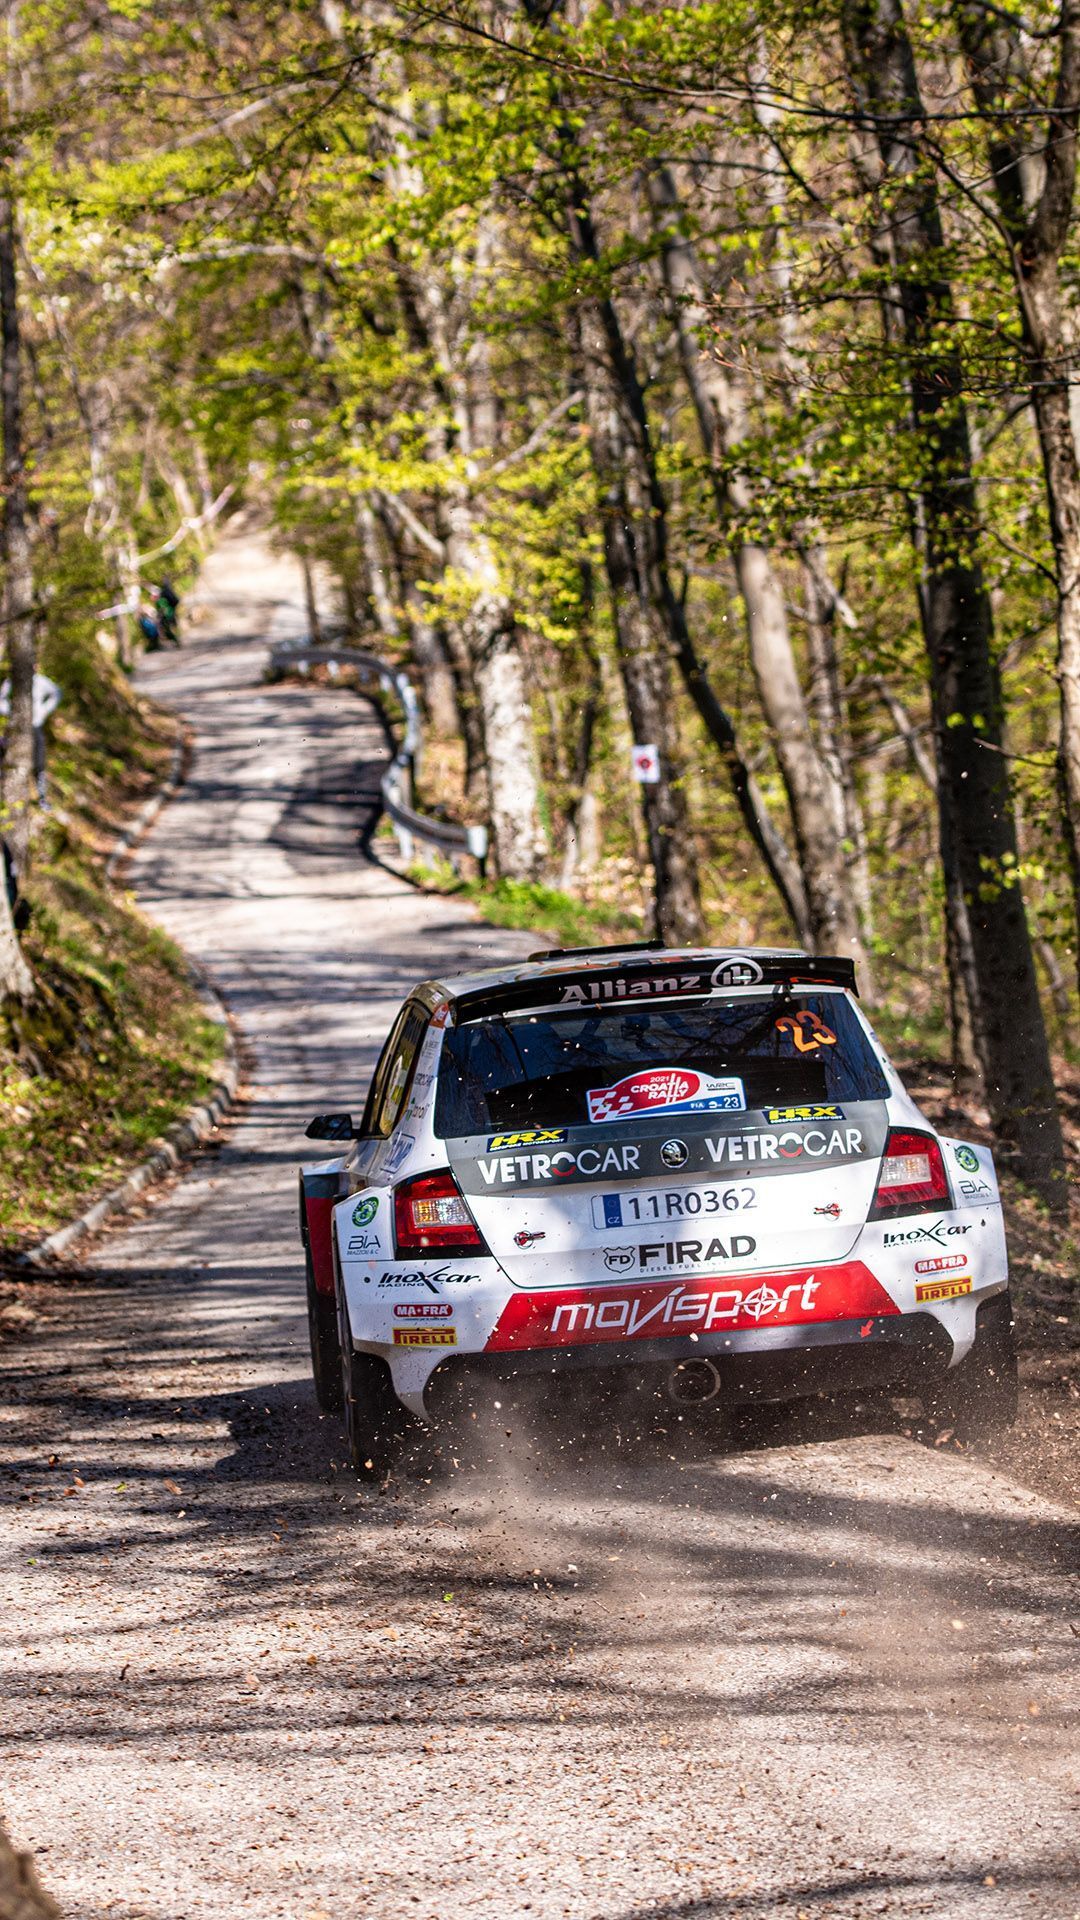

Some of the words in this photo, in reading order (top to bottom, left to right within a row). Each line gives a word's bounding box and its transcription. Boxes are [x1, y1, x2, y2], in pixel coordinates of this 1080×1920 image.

[560, 975, 701, 1003] Allianz
[775, 1010, 837, 1053] 23
[630, 1080, 690, 1094] CROATIA
[648, 1091, 688, 1101] RALLY
[723, 1097, 740, 1109] 23
[769, 1106, 837, 1121] HRX
[490, 1129, 565, 1147] HRX
[704, 1128, 863, 1163] VETROCAR
[477, 1145, 640, 1185] VETROCAR
[628, 1187, 758, 1220] 11R0362
[607, 1216, 621, 1224] CZ
[638, 1235, 757, 1267] FIRAD
[608, 1255, 631, 1265] FD
[640, 1265, 673, 1274] DIESEL
[915, 1278, 972, 1301] PIRELLI
[394, 1329, 456, 1345] PIRELLI
